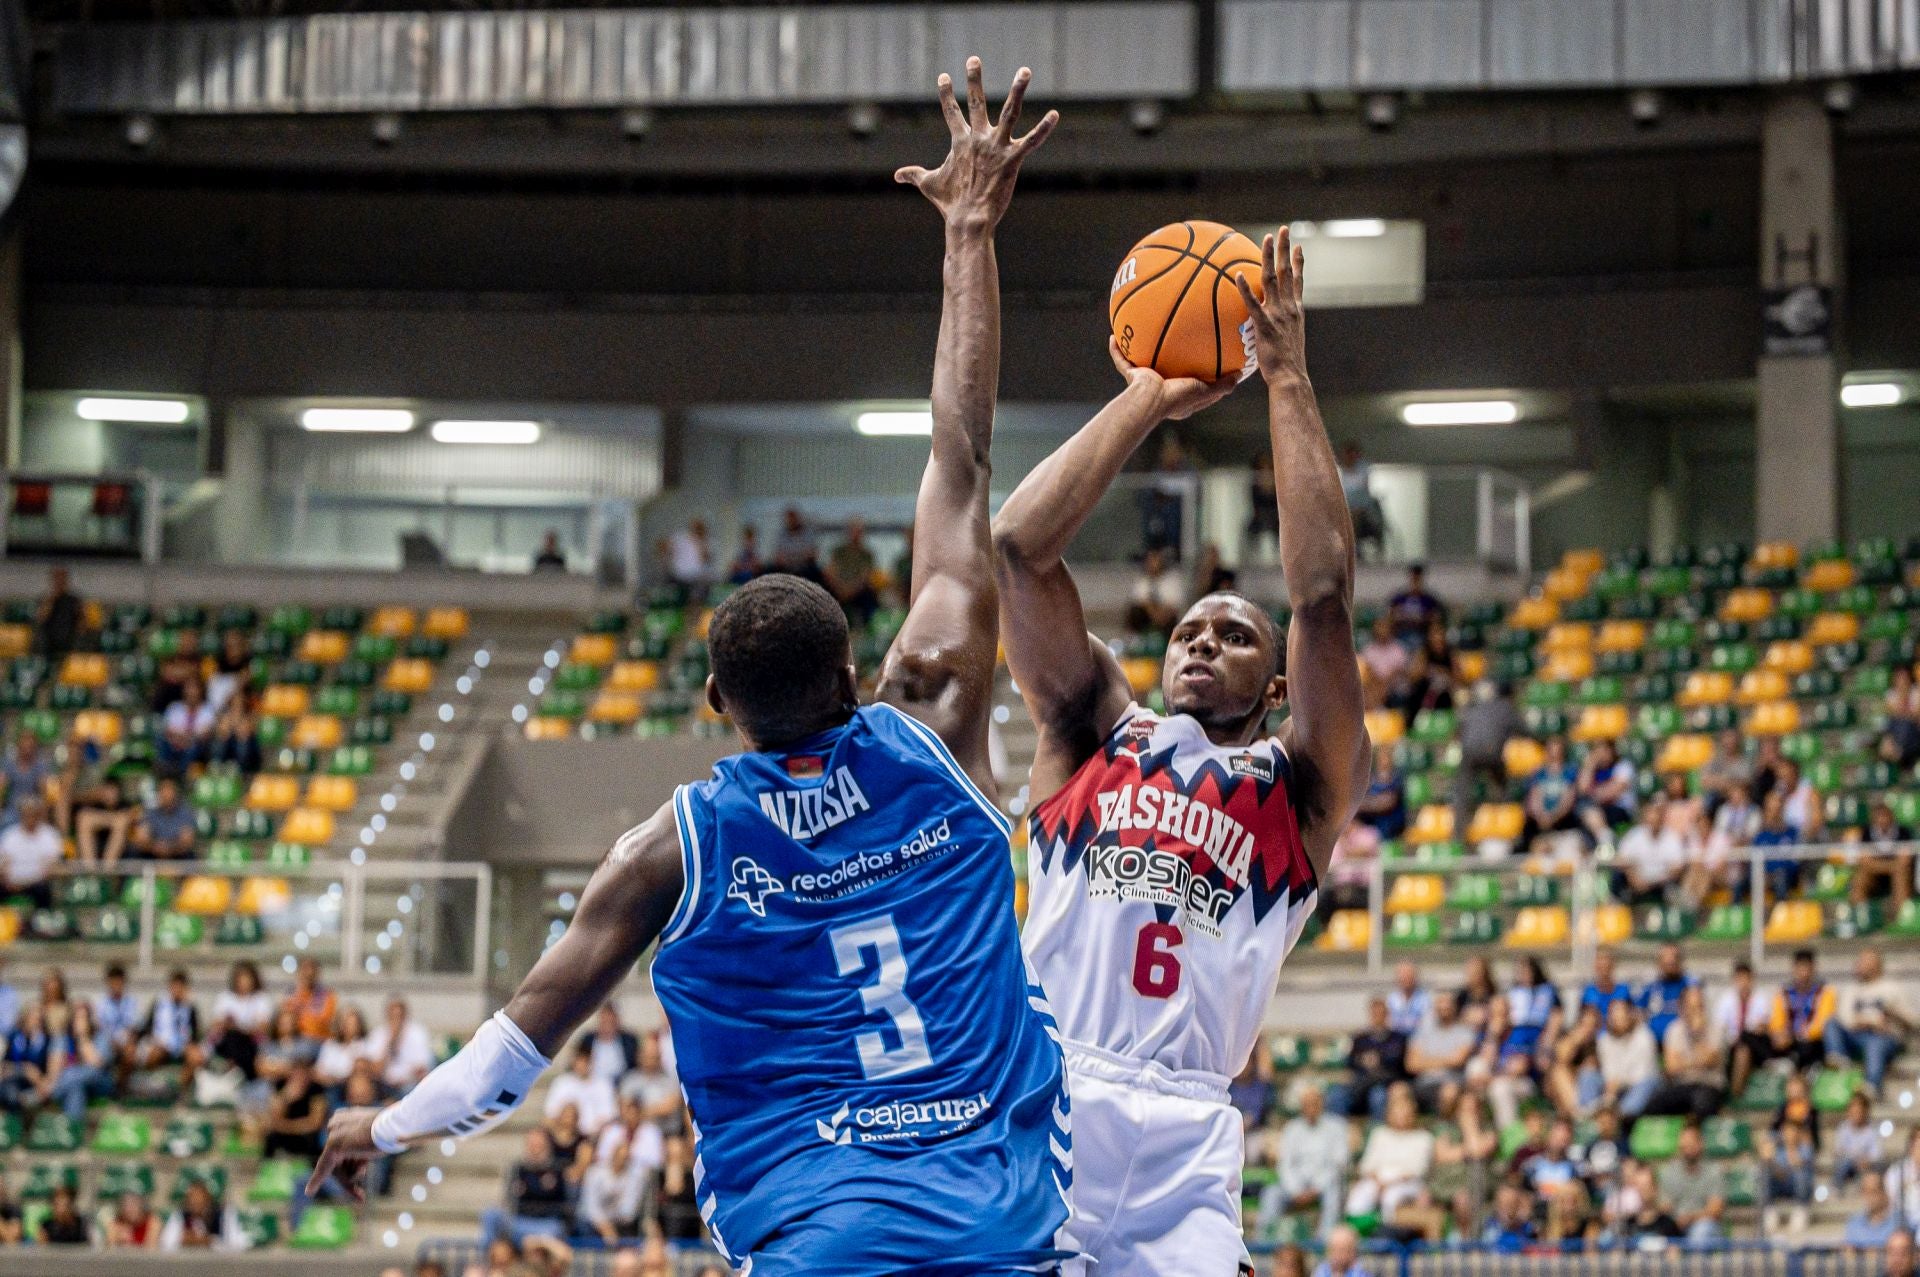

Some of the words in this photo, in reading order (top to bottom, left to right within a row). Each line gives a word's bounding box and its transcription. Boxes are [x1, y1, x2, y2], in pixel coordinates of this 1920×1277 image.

[758, 765, 871, 840] NZOSA
[791, 850, 894, 891] recoletas
[900, 818, 951, 859] salud
[829, 913, 934, 1081] 3
[1132, 921, 1184, 999] 6
